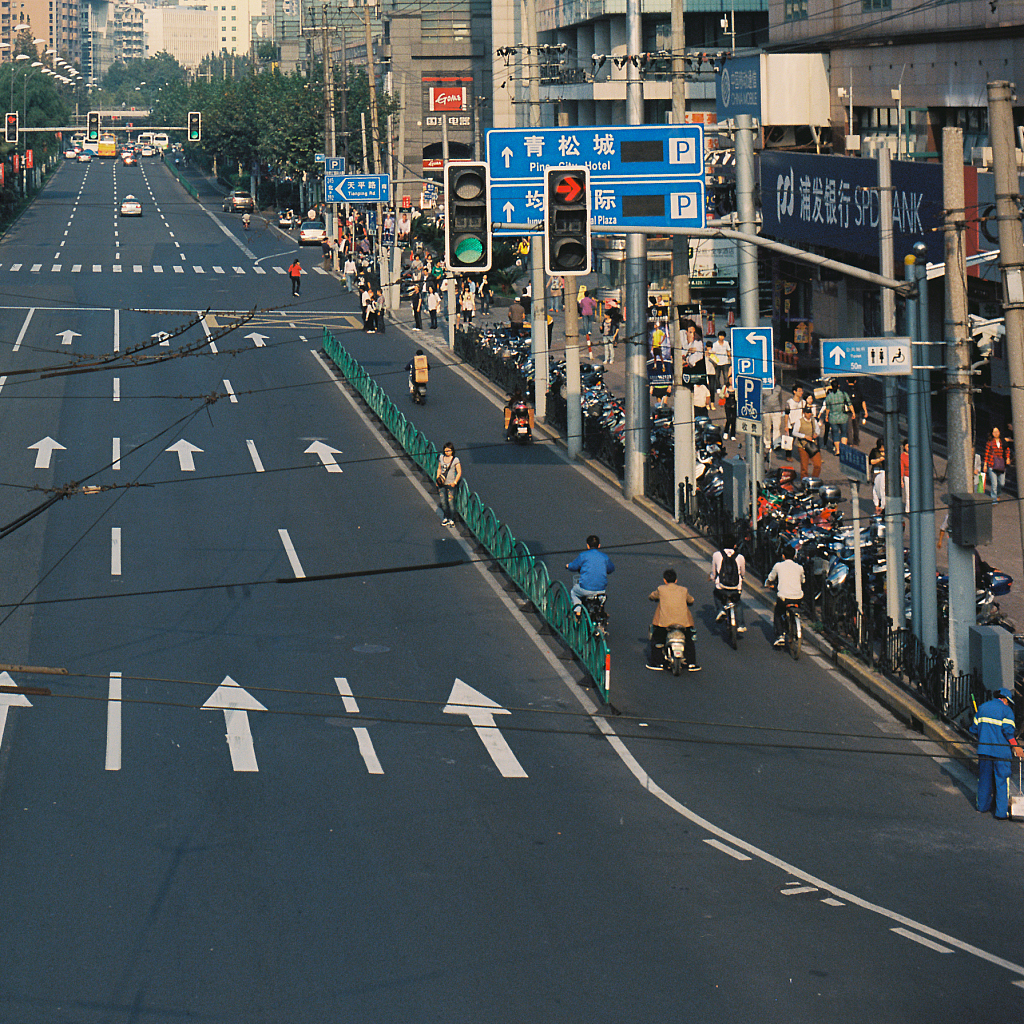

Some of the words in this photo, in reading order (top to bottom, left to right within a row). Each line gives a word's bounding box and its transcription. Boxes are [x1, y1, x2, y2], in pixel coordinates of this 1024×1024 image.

[523, 133, 616, 157] 青松城
[676, 140, 690, 162] P
[584, 160, 611, 170] Hotel
[347, 181, 376, 190] 天平路
[525, 189, 616, 212] 均际
[677, 195, 691, 215] P
[799, 175, 851, 228] 浦发银行
[598, 216, 617, 225] Plaza
[891, 190, 925, 236] ANK
[741, 360, 751, 373] P
[744, 379, 754, 399] P
